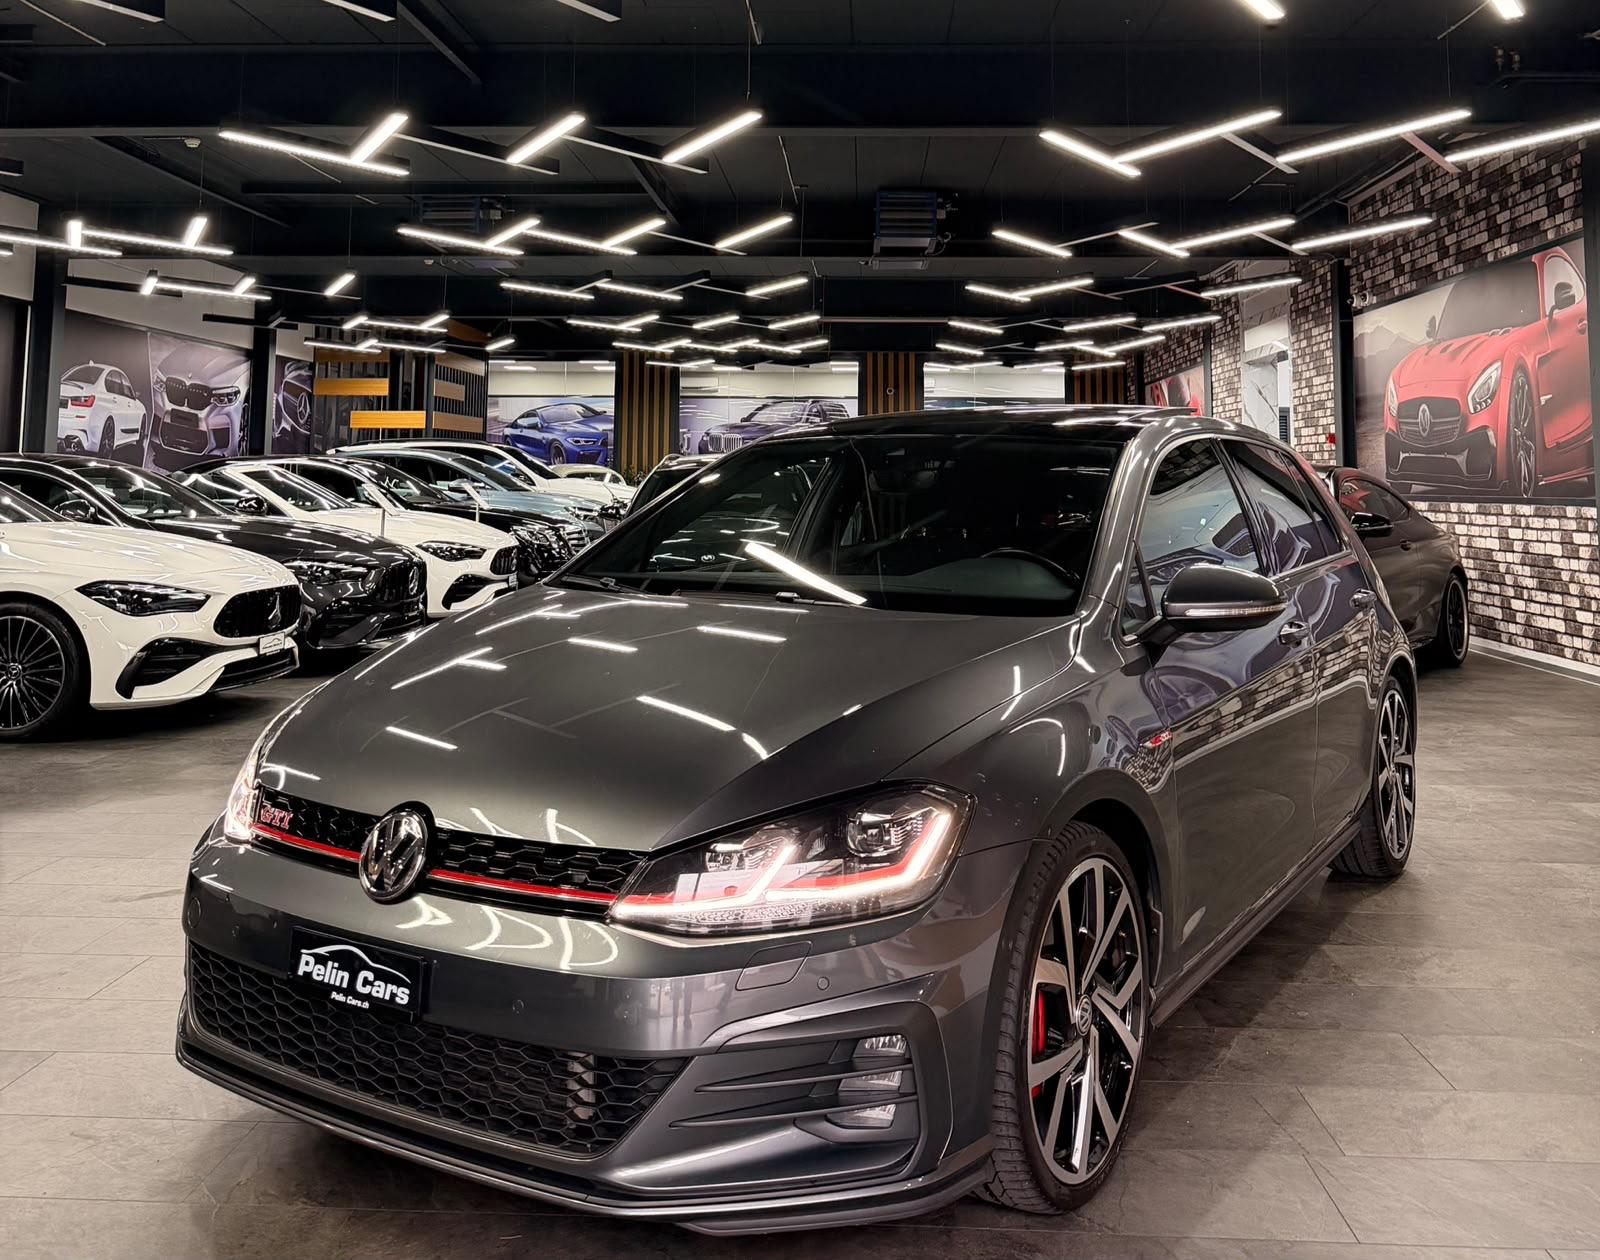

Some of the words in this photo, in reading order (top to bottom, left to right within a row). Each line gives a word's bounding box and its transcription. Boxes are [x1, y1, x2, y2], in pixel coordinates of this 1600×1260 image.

[260, 803, 294, 830] GTI
[297, 953, 350, 989] Pelin
[355, 970, 411, 1005] Cars
[330, 991, 346, 1003] Pelin
[346, 996, 370, 1009] Cars.ch
